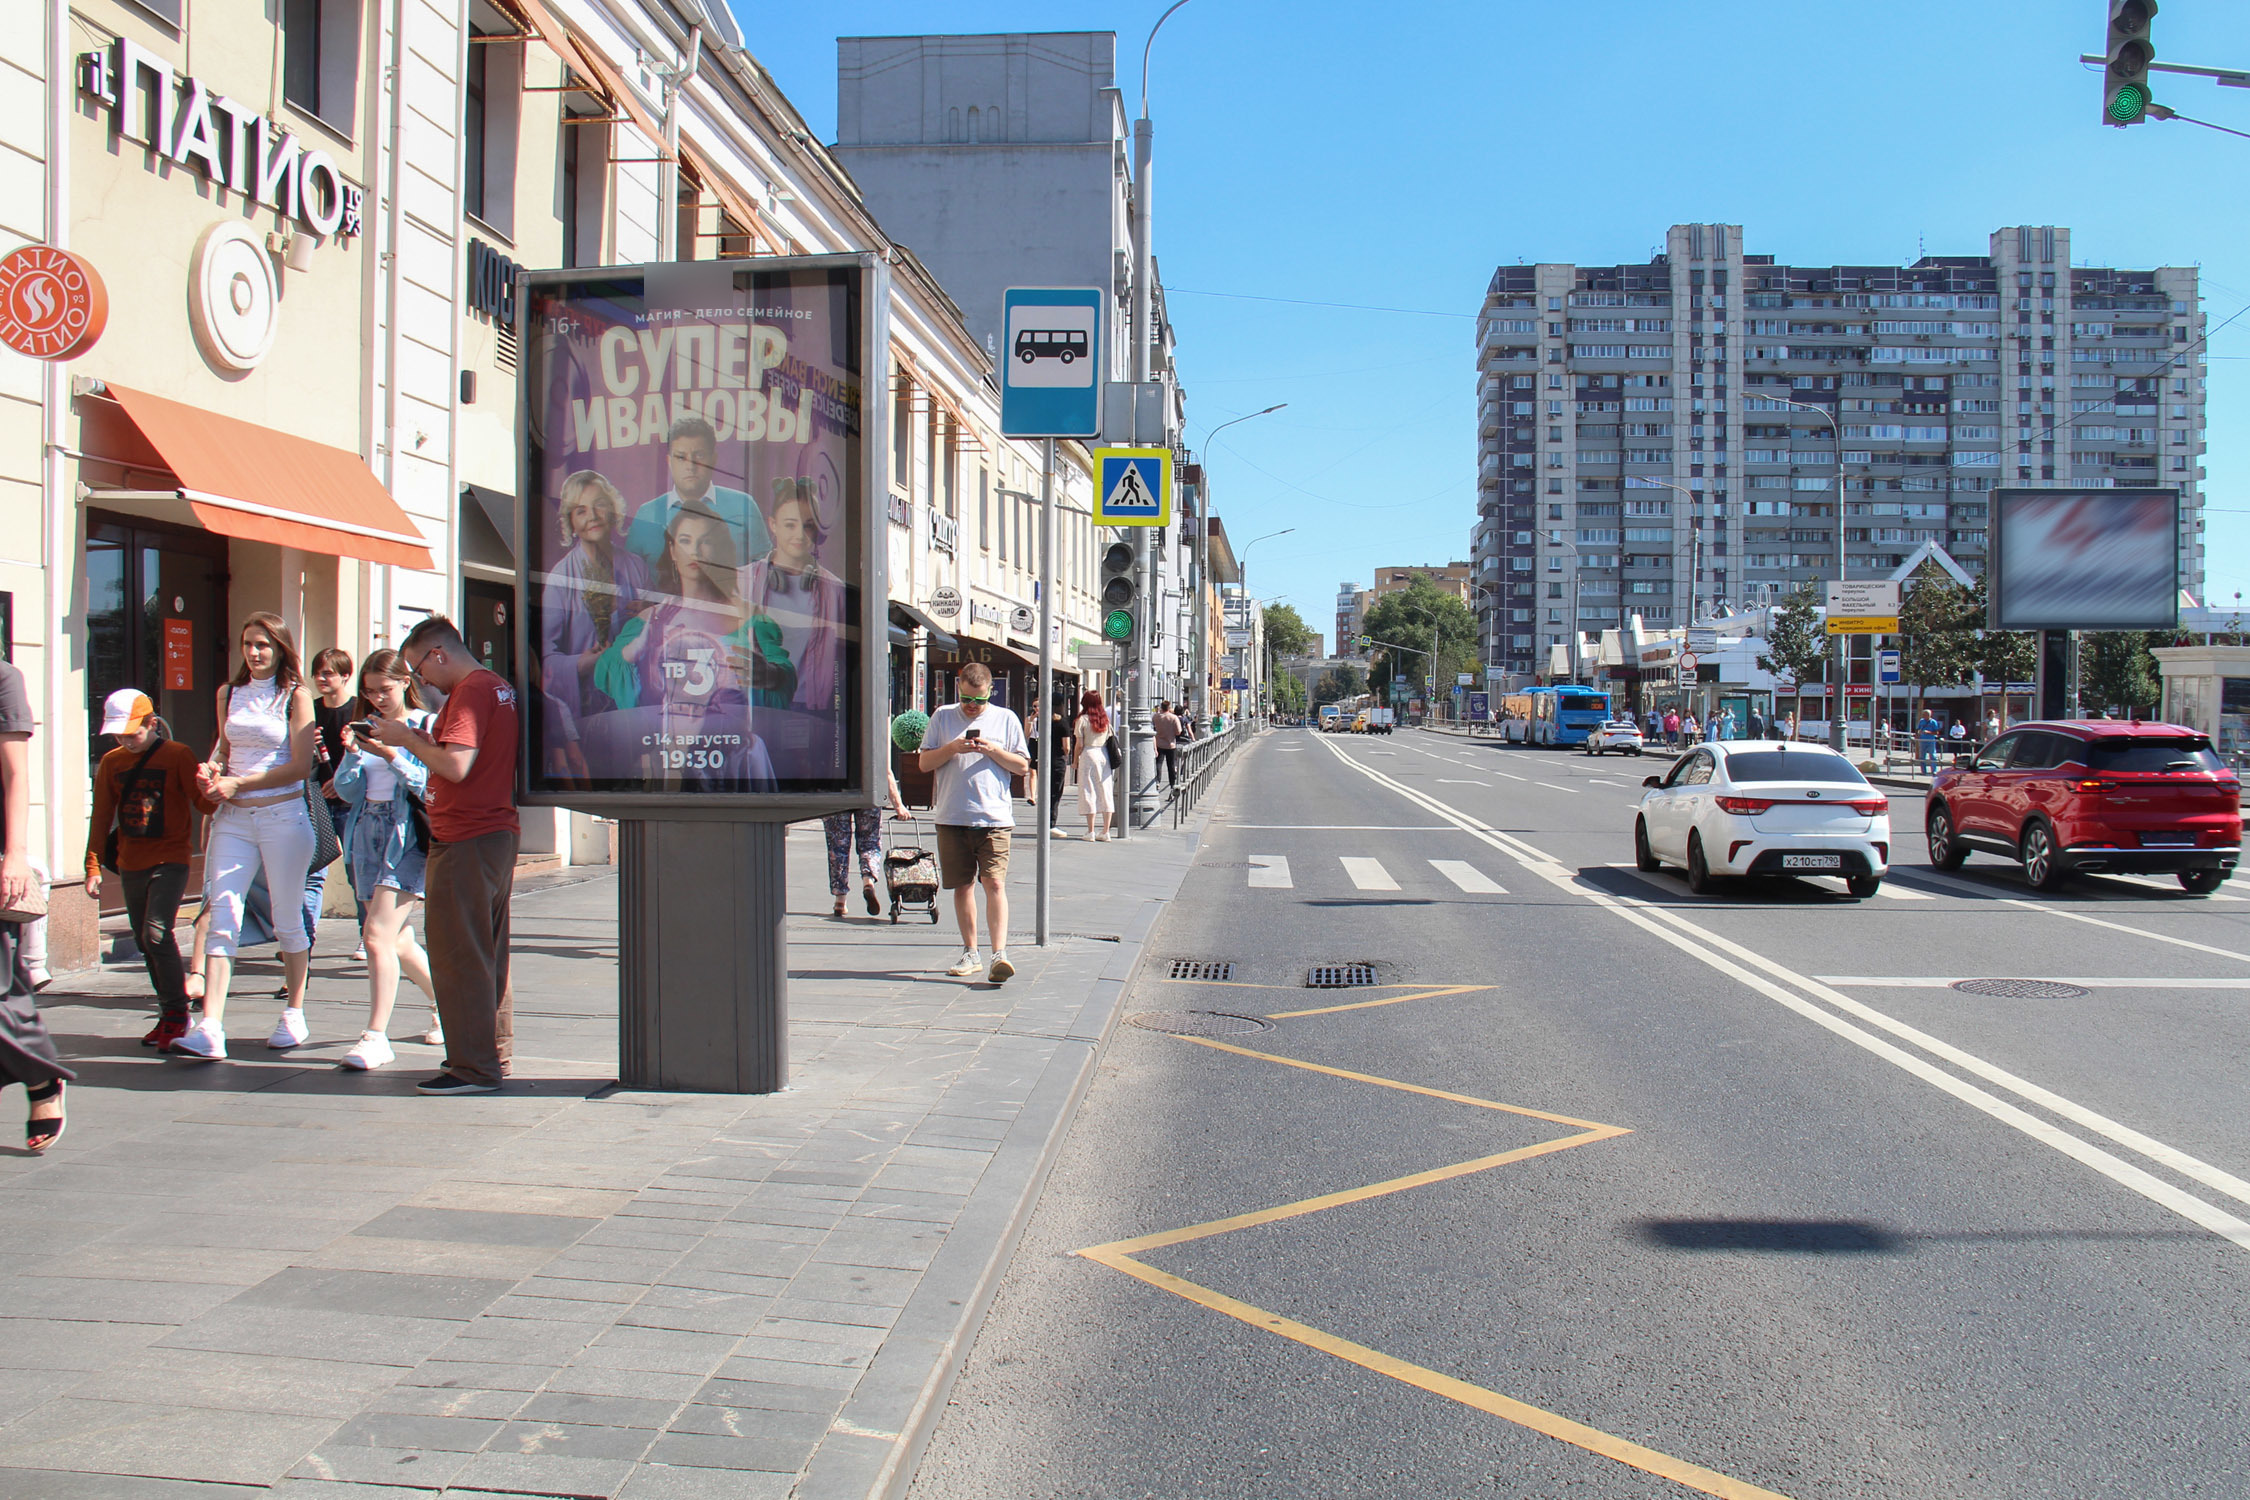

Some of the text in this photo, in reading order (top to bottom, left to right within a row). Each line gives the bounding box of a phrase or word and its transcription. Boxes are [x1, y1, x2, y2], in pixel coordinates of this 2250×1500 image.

[115, 37, 345, 236] ПАТИО
[72, 294, 85, 304] 93
[635, 310, 682, 324] МАГИЯ
[694, 308, 733, 320] ДЕЛО
[736, 306, 813, 321] СЕМЕЙНОЕ
[549, 317, 581, 335] 16+
[600, 325, 788, 397] СУПЕР
[572, 388, 815, 453] ИВАНОВЫ
[946, 647, 993, 664] ПАБ
[642, 732, 741, 748] с 14 августа
[660, 750, 724, 769] 19:30
[1823, 856, 1839, 864] 790
